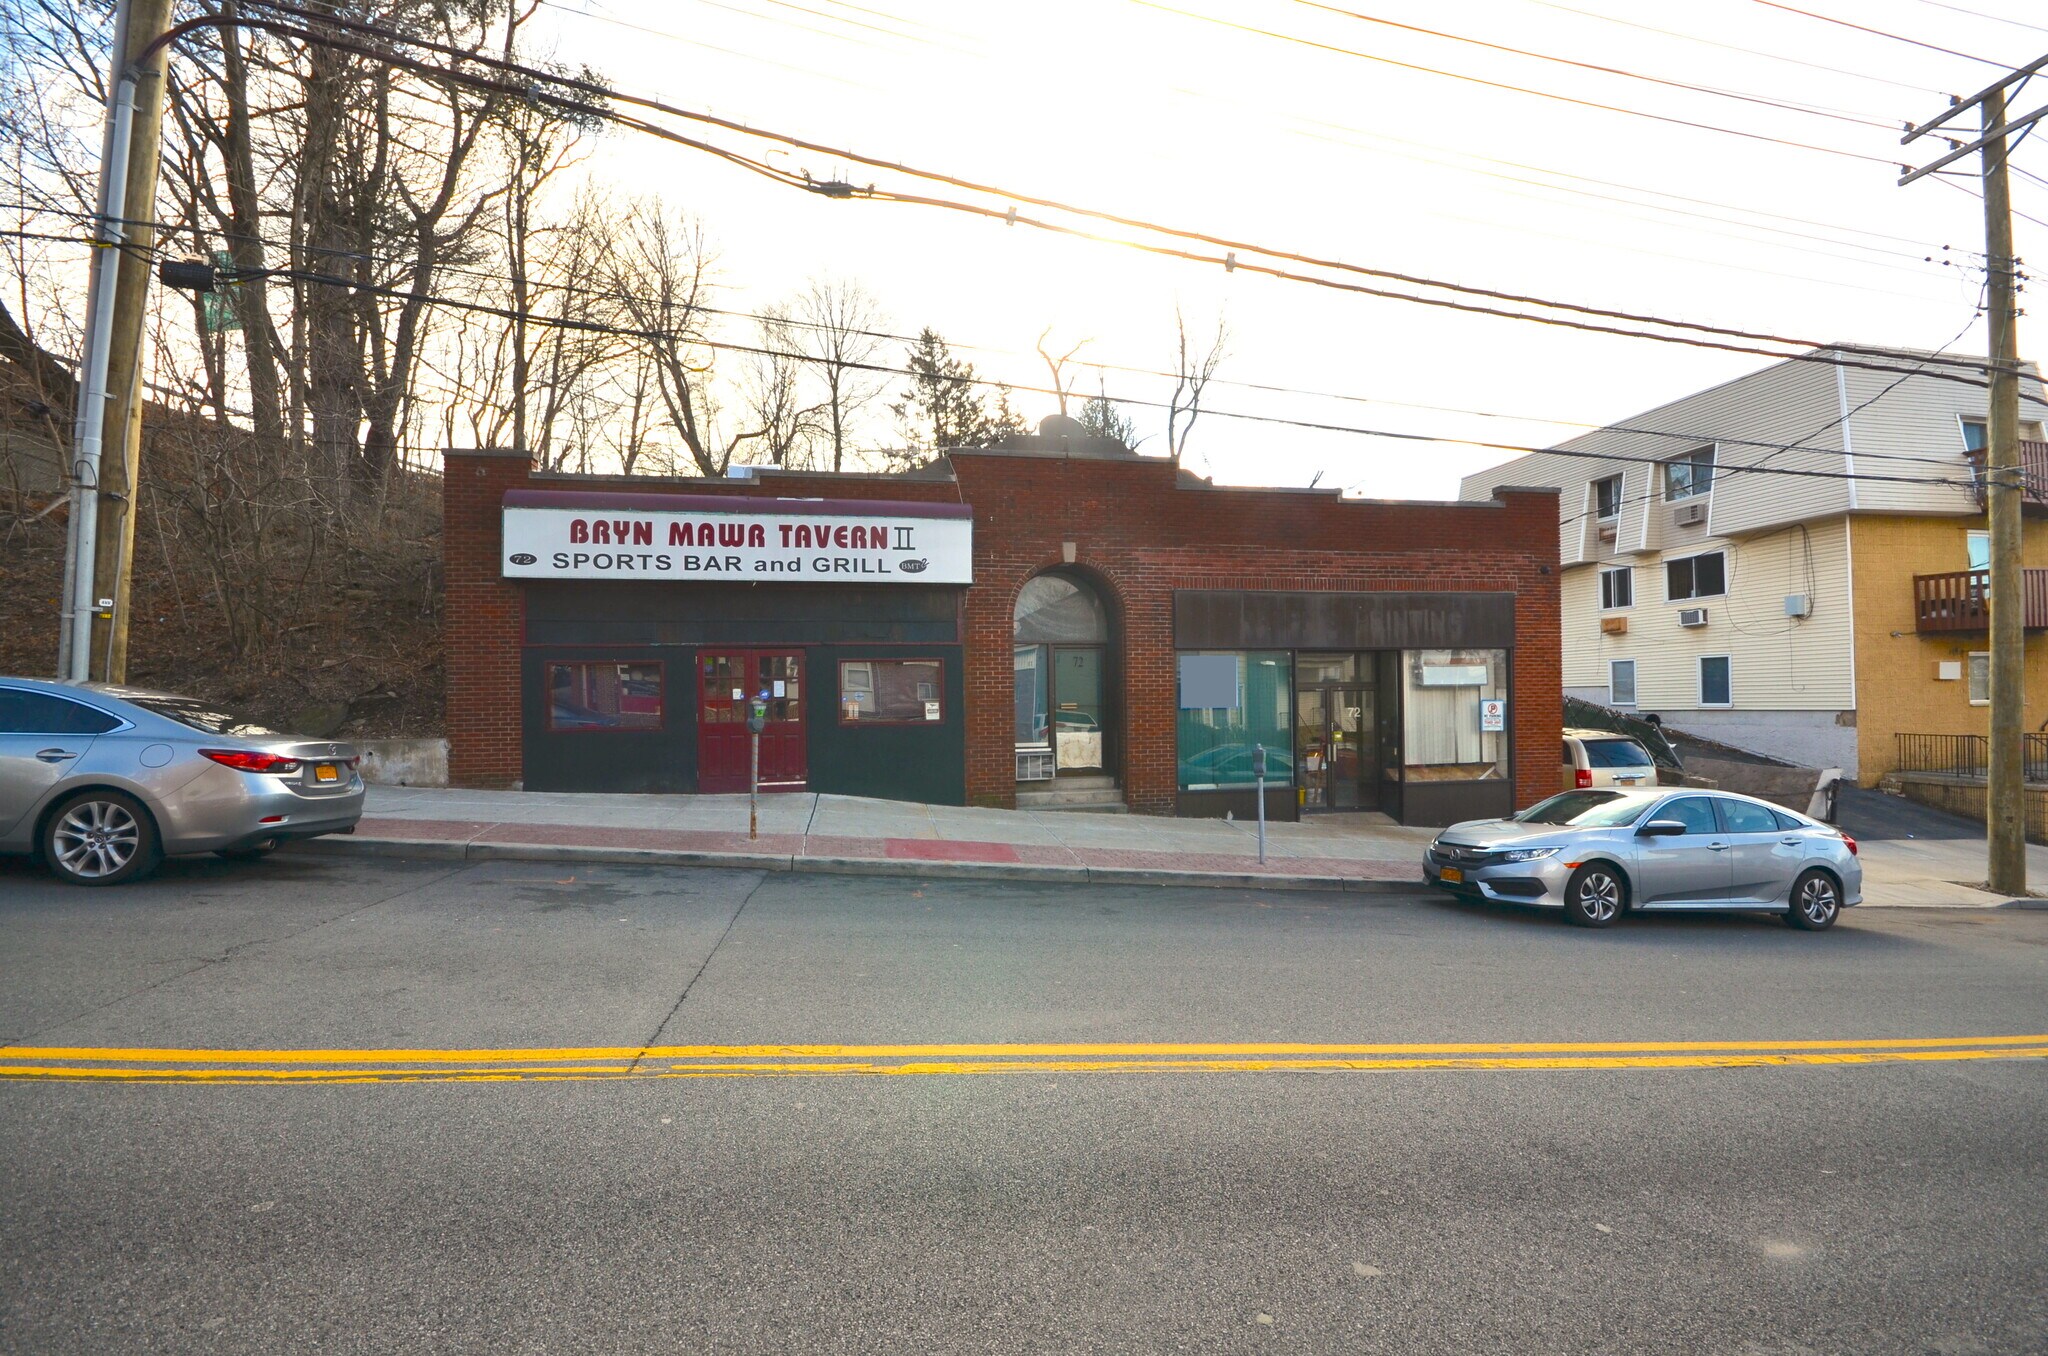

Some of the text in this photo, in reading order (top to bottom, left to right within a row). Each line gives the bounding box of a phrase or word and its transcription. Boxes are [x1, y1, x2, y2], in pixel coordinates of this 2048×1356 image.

[570, 518, 916, 551] BRYN MAWR TAVERN II
[552, 552, 892, 574] SPORTS BAR and GRILL
[1072, 656, 1084, 668] 72
[1347, 707, 1361, 718] 72
